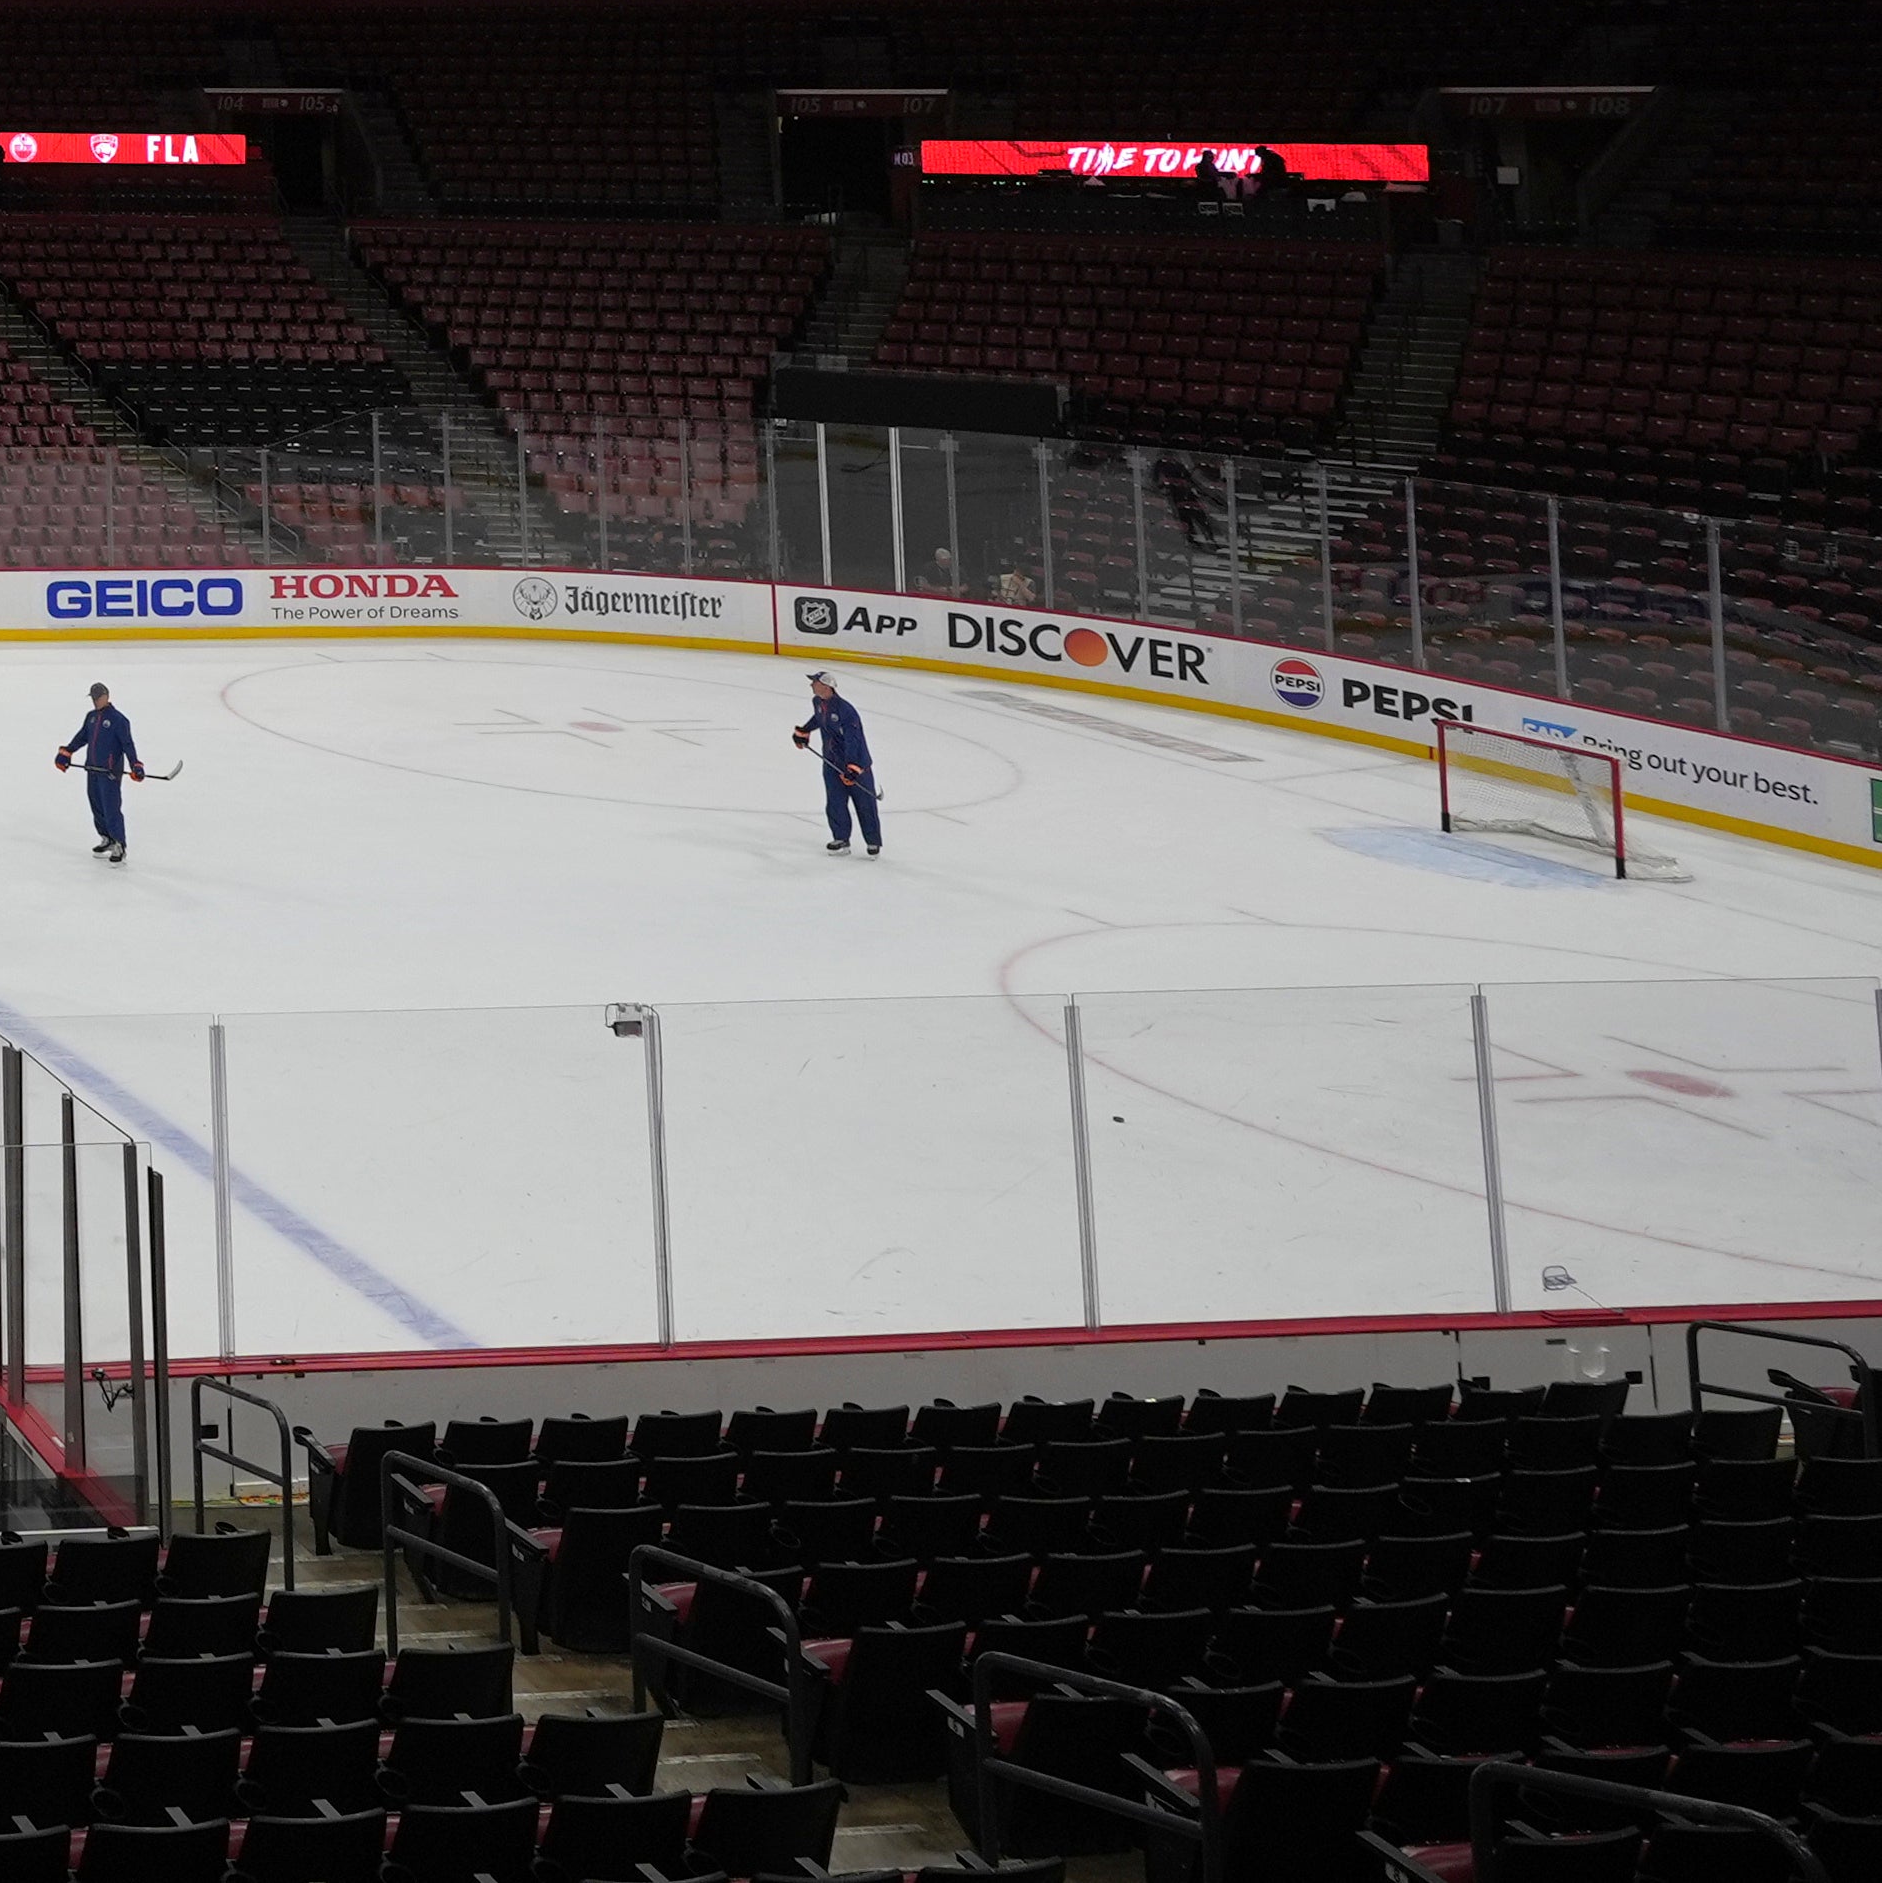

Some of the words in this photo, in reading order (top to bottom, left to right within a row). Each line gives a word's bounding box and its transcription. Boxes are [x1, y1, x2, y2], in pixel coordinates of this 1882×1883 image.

[146, 134, 200, 163] FLA
[1143, 147, 1181, 173] TO
[46, 577, 243, 618] GEICO
[269, 574, 459, 598] HONDA
[272, 606, 304, 619] The
[309, 606, 363, 619] Power
[367, 605, 385, 618] of
[948, 612, 1209, 685] DISCOVER
[1274, 672, 1321, 694] PEPSI
[1341, 677, 1474, 735] PEPSI
[1646, 753, 1687, 775] out
[1691, 758, 1748, 792] your
[1752, 770, 1818, 807] best.
